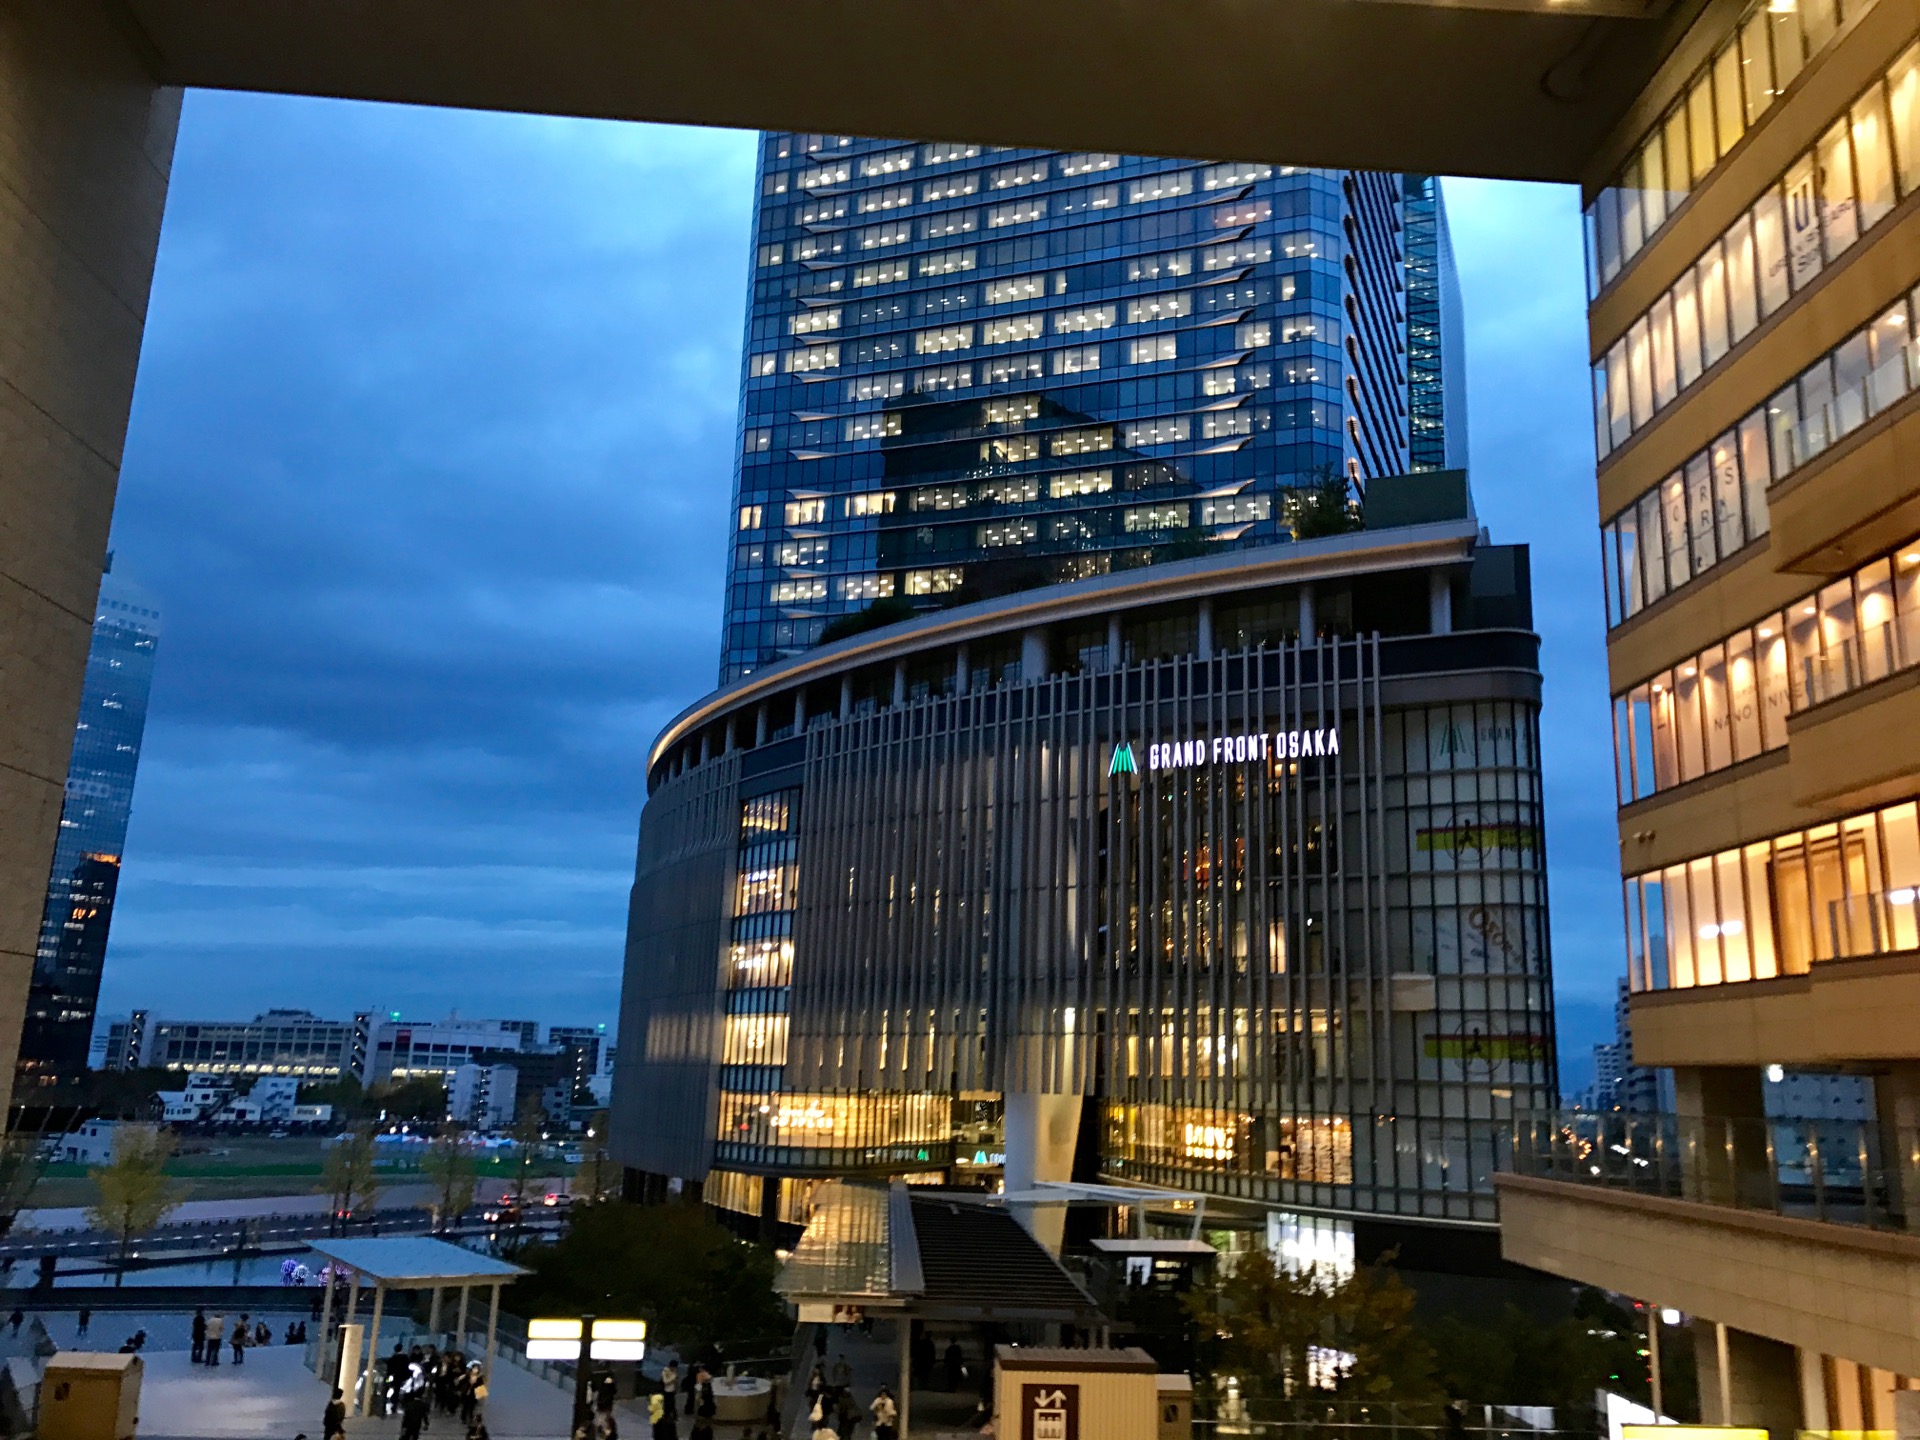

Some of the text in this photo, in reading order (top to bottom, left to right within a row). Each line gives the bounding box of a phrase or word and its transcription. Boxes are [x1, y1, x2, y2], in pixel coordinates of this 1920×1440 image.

[1150, 728, 1339, 770] GRAND FRONT OSAKA
